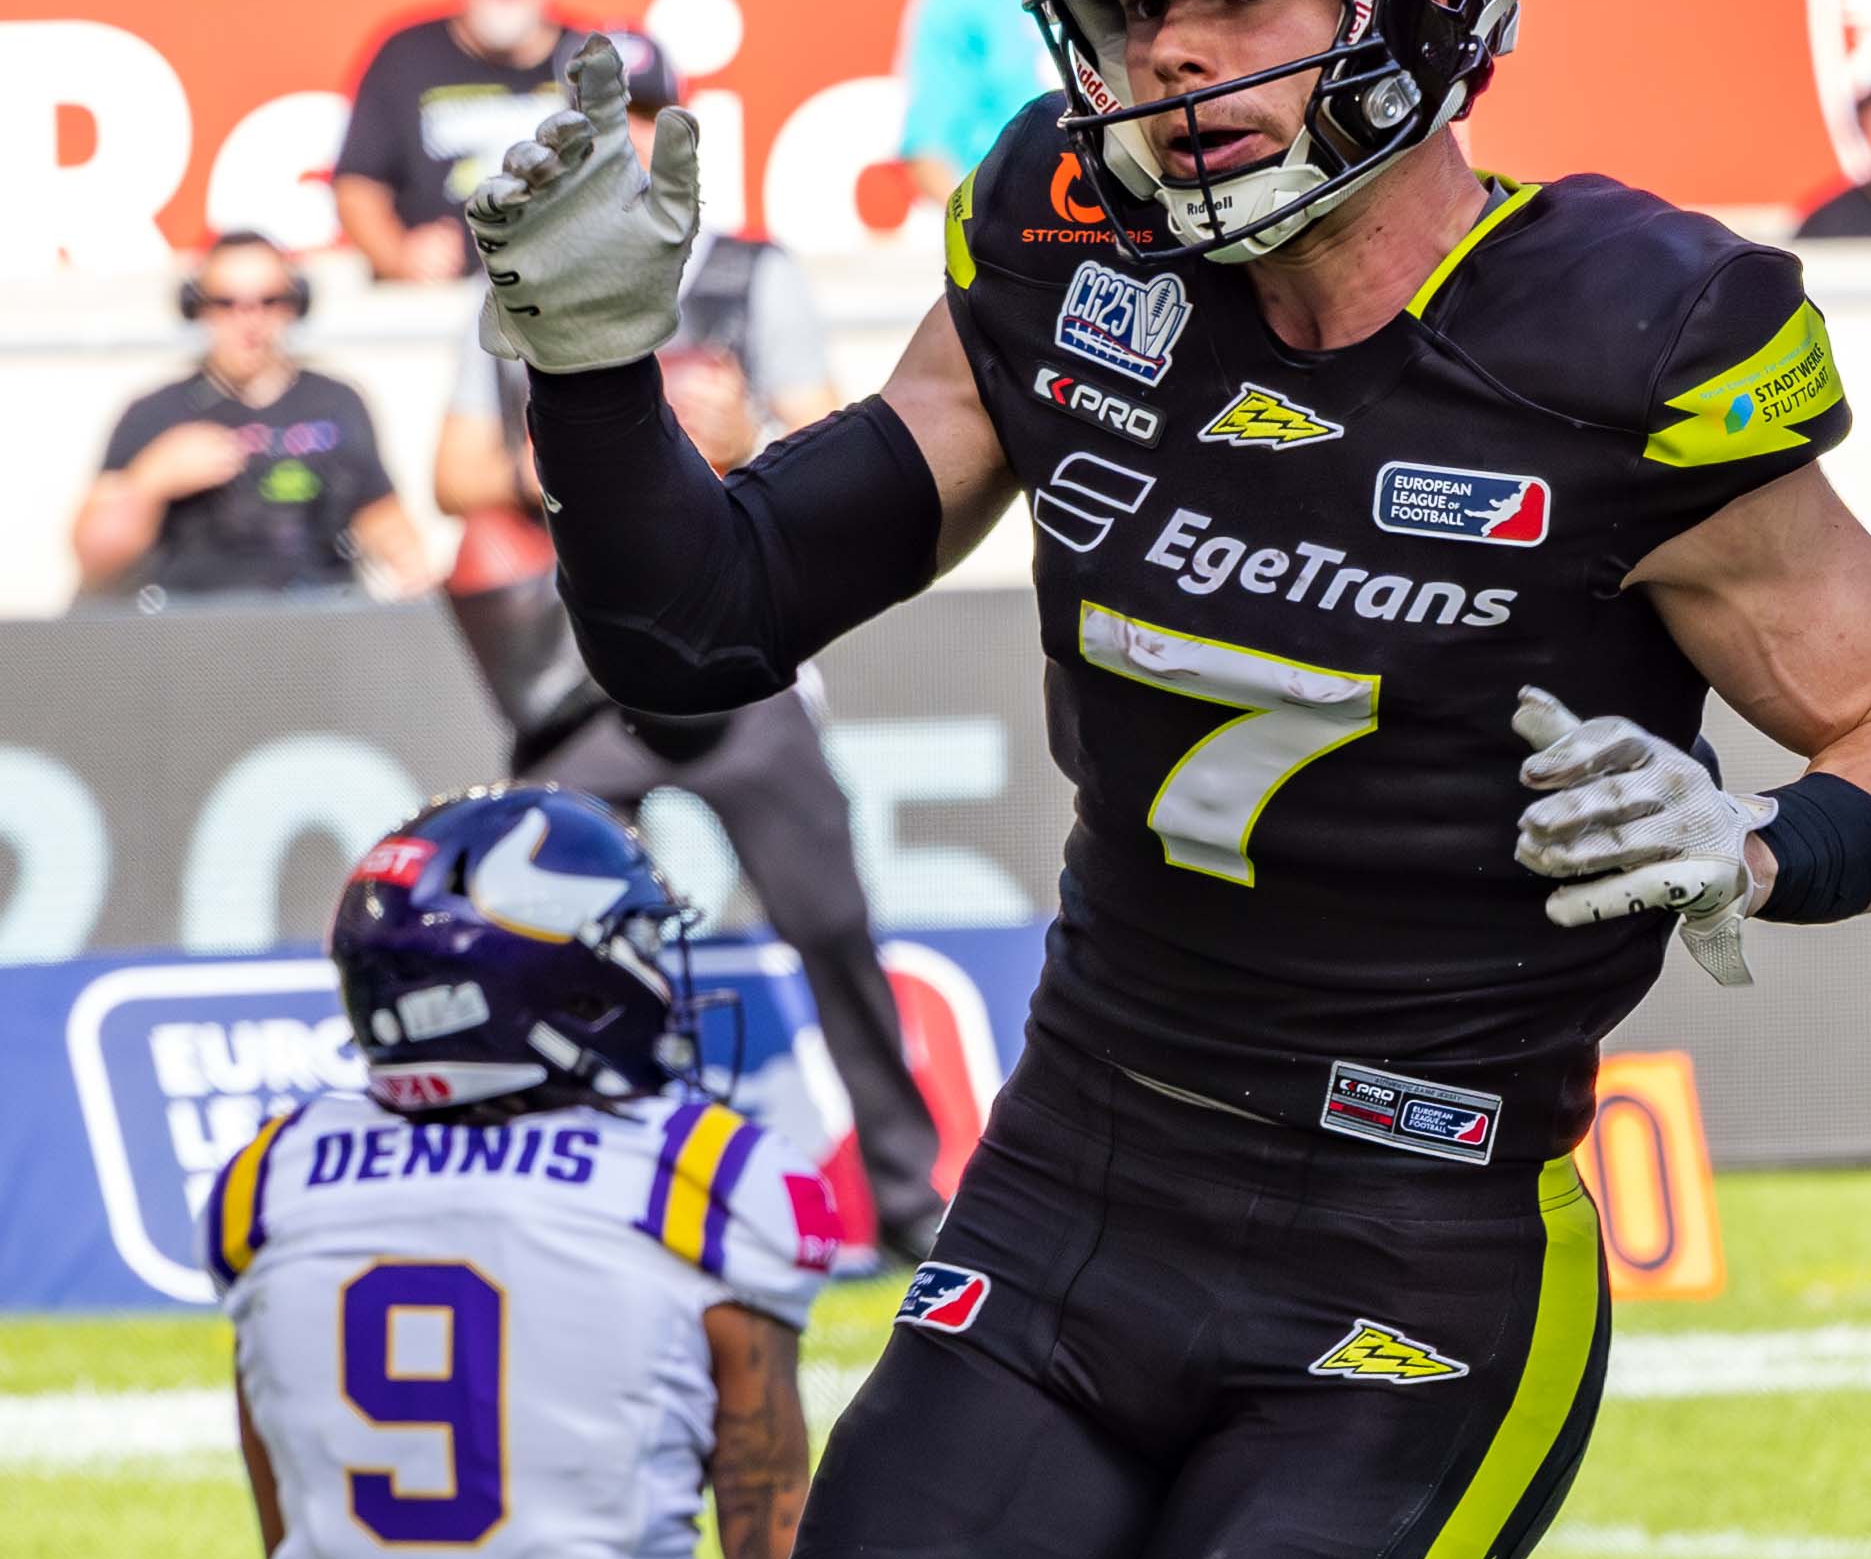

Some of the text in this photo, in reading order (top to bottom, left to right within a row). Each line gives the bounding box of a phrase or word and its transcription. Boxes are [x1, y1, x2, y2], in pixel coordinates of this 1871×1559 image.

[1187, 196, 1233, 216] Ridell
[1069, 268, 1135, 337] CG25
[1755, 342, 1825, 403] STADTWERKE
[1762, 366, 1829, 423] STUTTGART
[1392, 490, 1447, 509] LEAGUE
[1394, 475, 1472, 496] EUROPEAN
[1391, 506, 1465, 526] FOOTBALL
[1145, 508, 1518, 627] EgeTrans
[1080, 600, 1381, 888] 7
[1409, 1120, 1447, 1134] FOOTBALL
[1411, 1114, 1439, 1125] LEAGUE
[1413, 1106, 1453, 1120] EUROPEAN
[307, 1125, 600, 1184] DENNIS
[340, 1257, 510, 1549] 9
